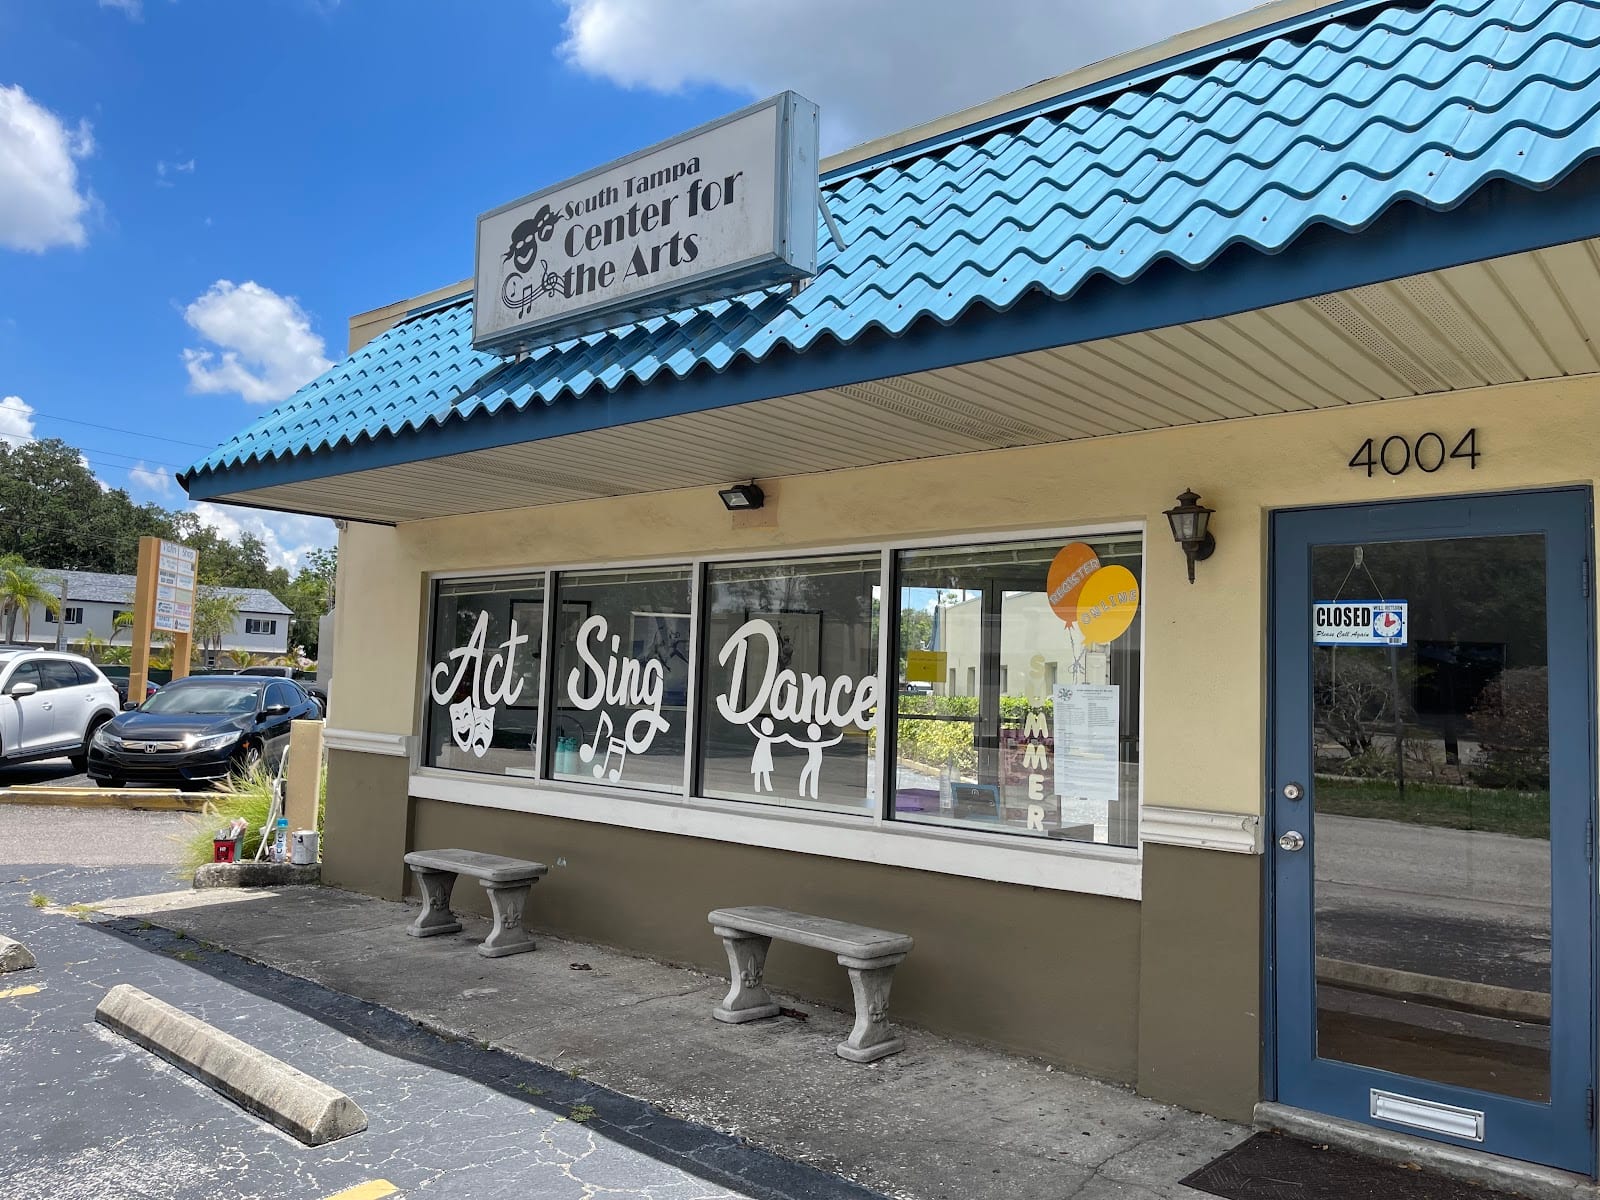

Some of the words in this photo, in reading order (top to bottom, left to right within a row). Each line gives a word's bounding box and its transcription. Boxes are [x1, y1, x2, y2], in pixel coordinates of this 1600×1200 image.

[563, 186, 619, 220] South
[624, 156, 701, 198] Tampa
[564, 194, 679, 258] Center
[686, 170, 743, 217] for
[562, 260, 616, 299] the
[623, 232, 699, 282] Arts
[1348, 428, 1481, 477] 4004
[1049, 558, 1101, 606] REGISTER
[1081, 589, 1137, 625] ONLINE
[1316, 607, 1371, 627] CLOSED
[1336, 630, 1350, 638] Call
[1351, 631, 1370, 639] Again
[431, 610, 528, 706] Act
[567, 615, 670, 755] Sing
[716, 618, 879, 731] Dance
